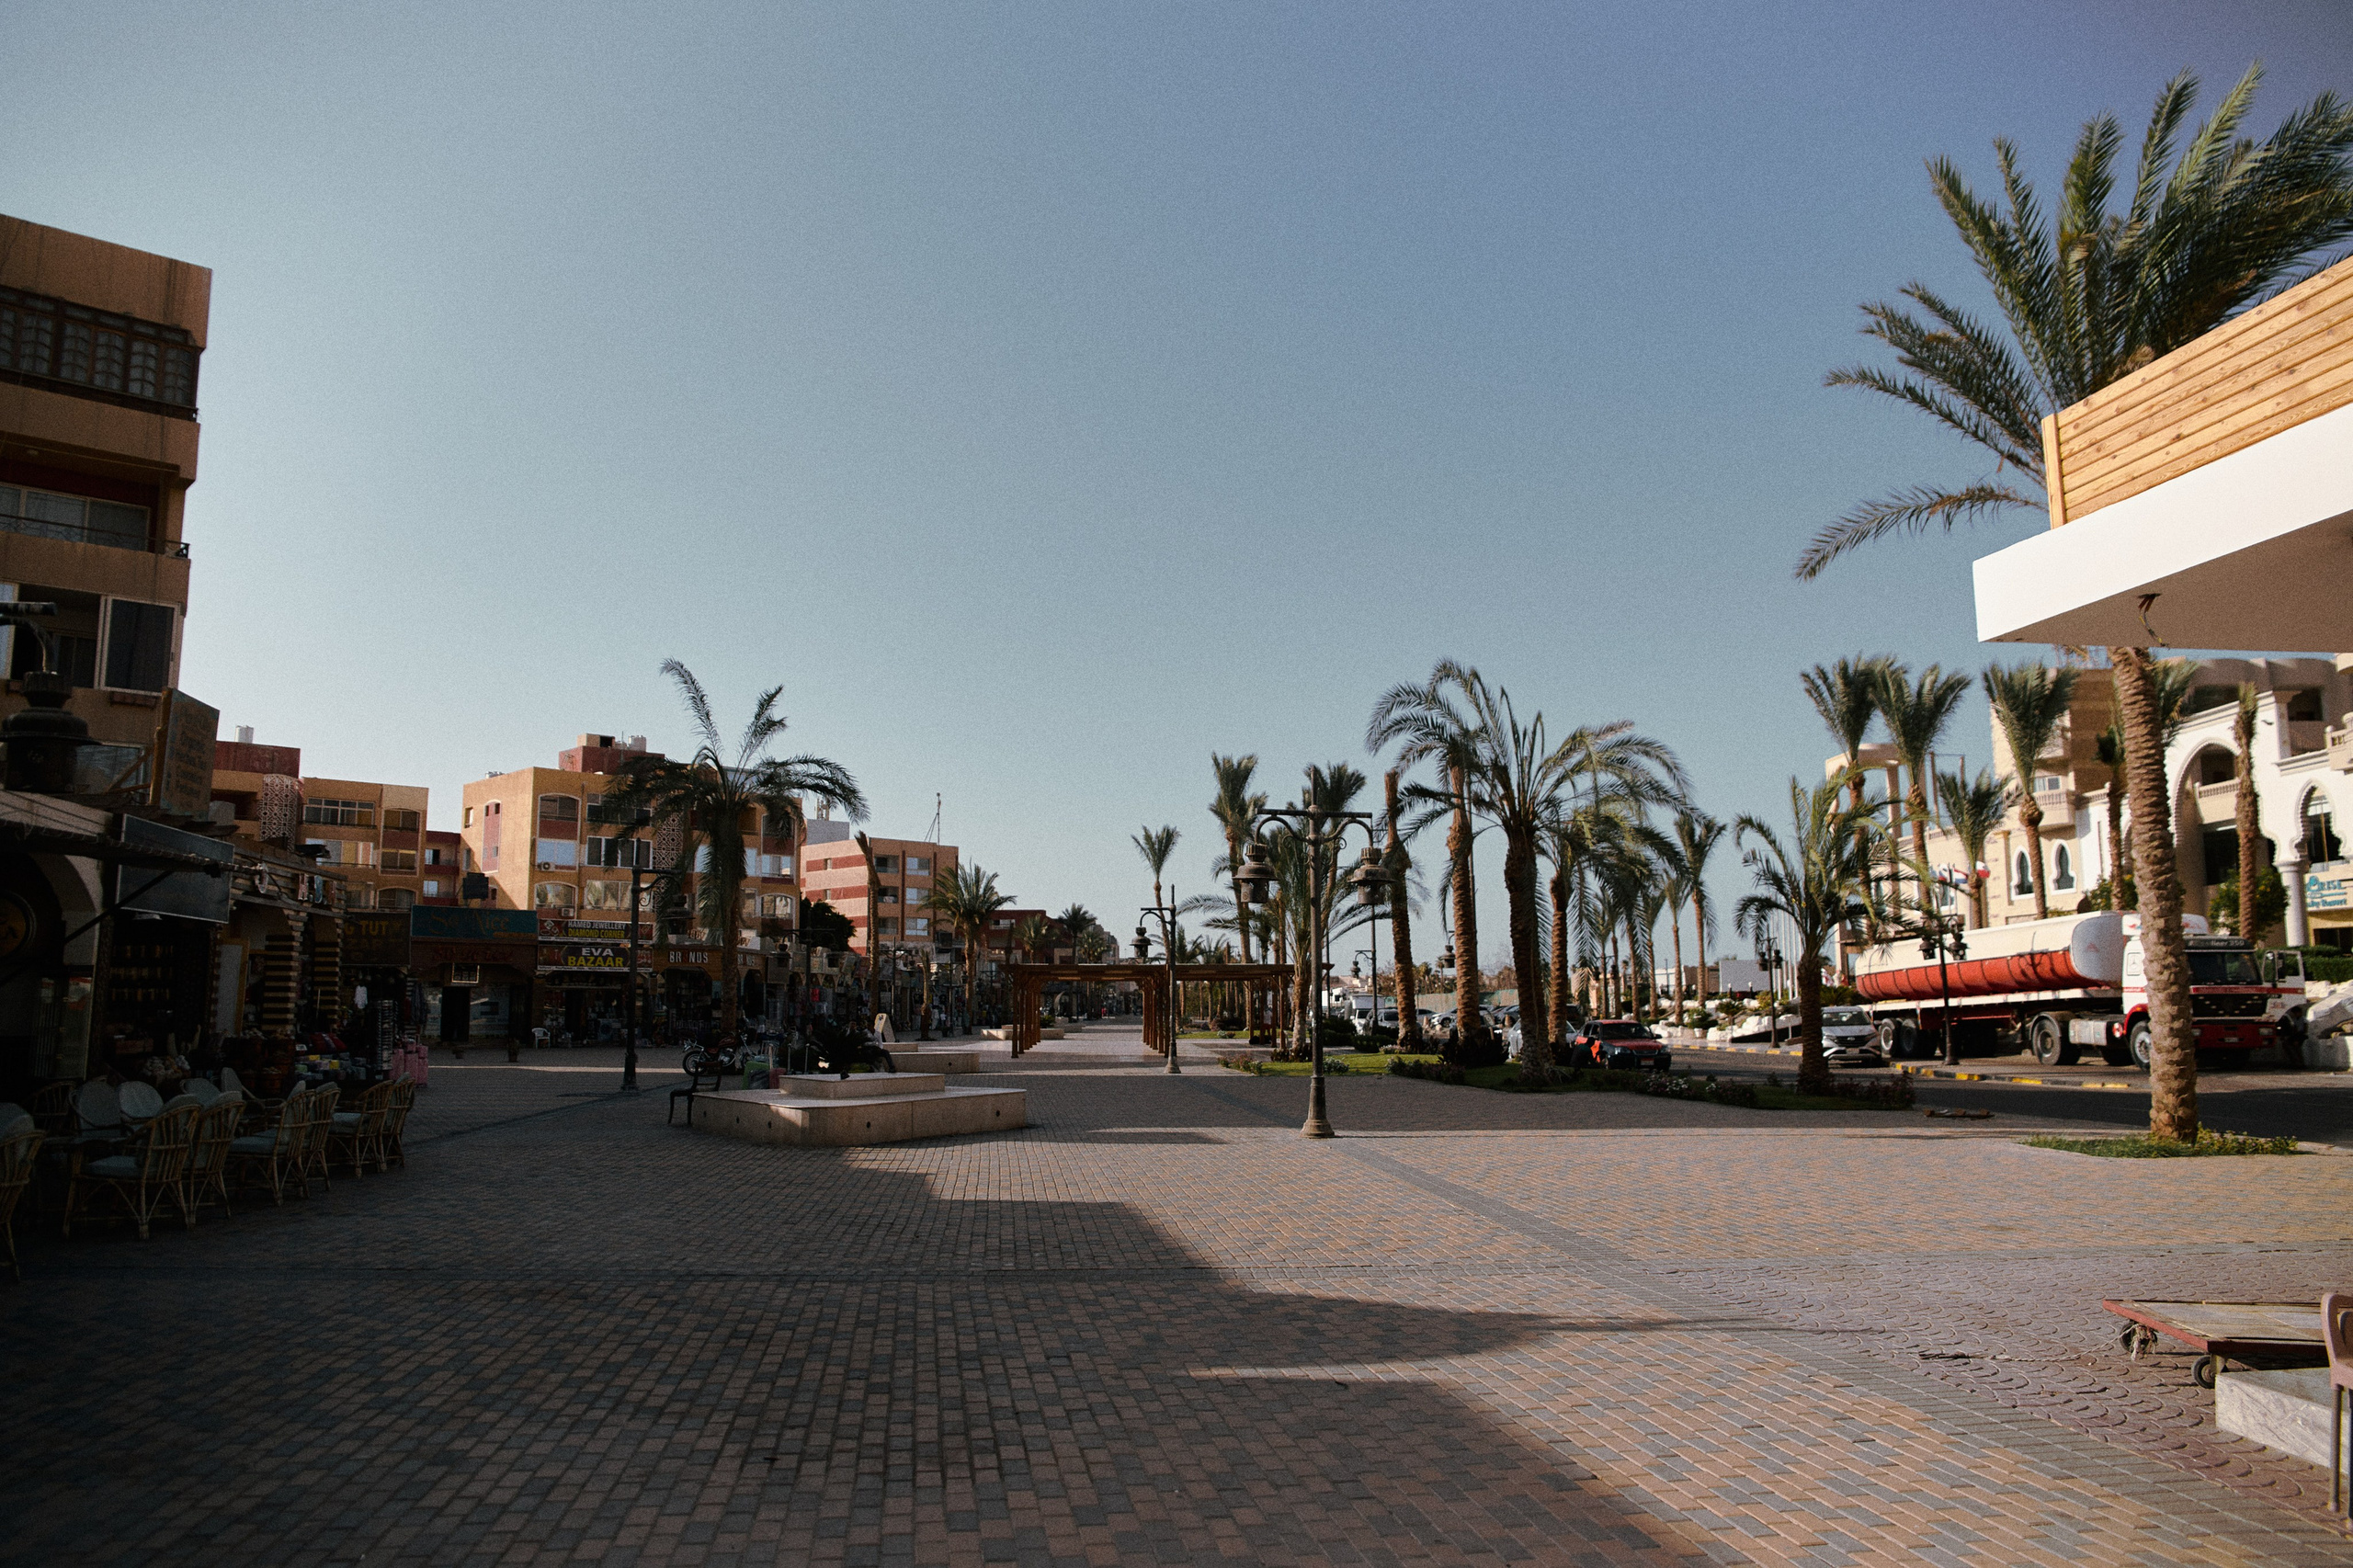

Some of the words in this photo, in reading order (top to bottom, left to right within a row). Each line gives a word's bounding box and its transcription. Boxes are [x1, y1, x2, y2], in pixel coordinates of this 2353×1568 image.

[359, 920, 390, 937] TUT
[592, 922, 627, 930] JEWELLERY
[567, 928, 599, 937] DIAMOND
[600, 929, 625, 938] CORNER
[581, 948, 614, 957] EVA
[567, 956, 624, 968] BAZAAR
